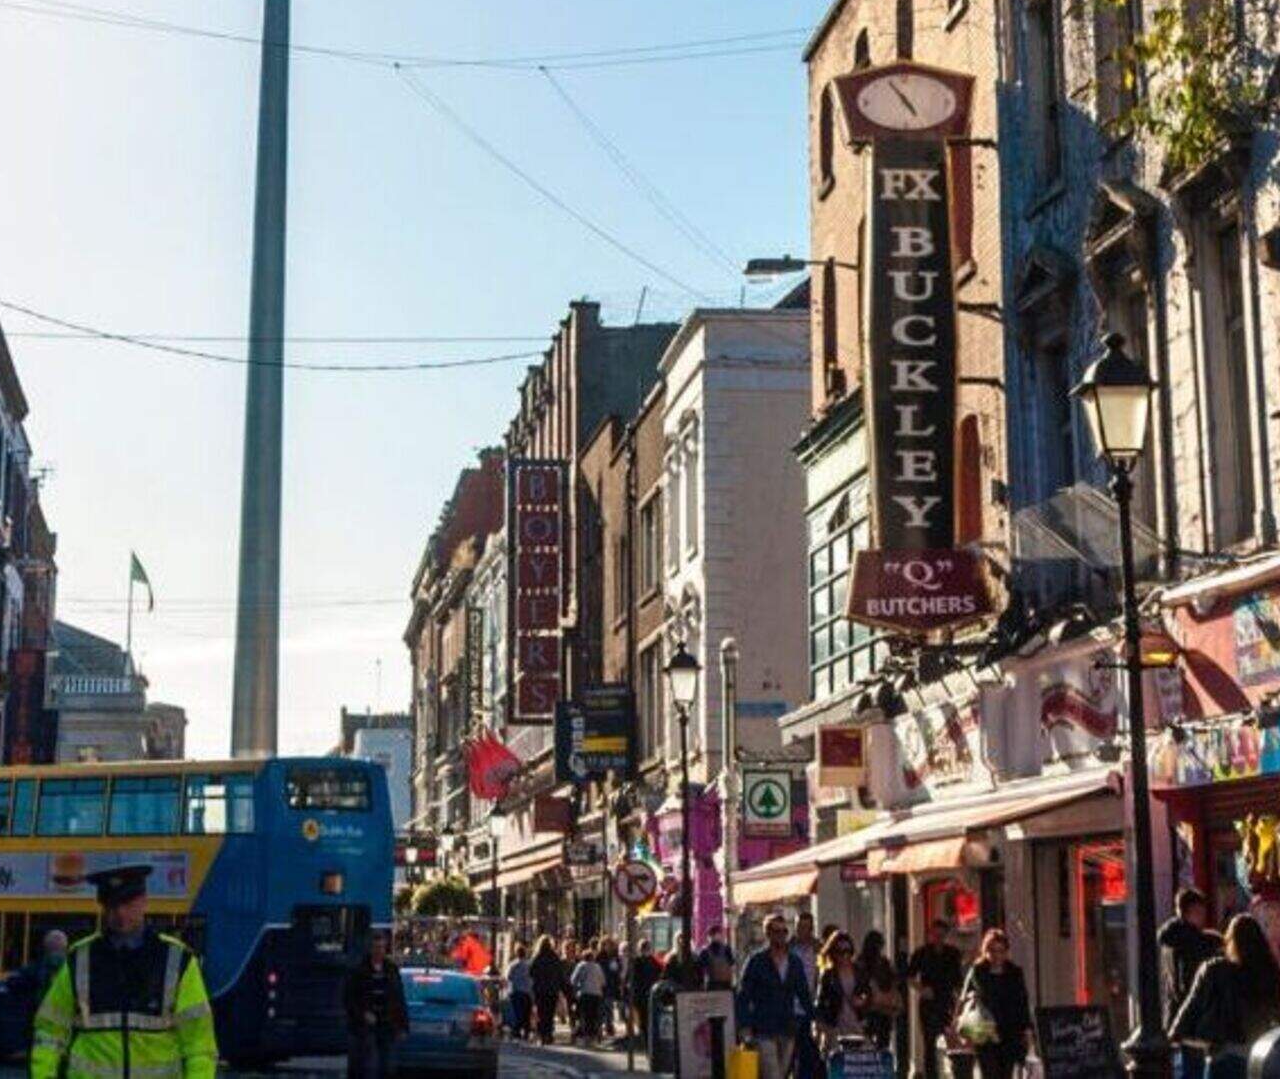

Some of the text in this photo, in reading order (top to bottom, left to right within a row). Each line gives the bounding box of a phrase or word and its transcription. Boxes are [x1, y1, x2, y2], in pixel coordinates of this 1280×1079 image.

[879, 168, 941, 201] FX
[889, 226, 939, 530] BUCKLEY
[866, 595, 977, 618] BUTCHERS
